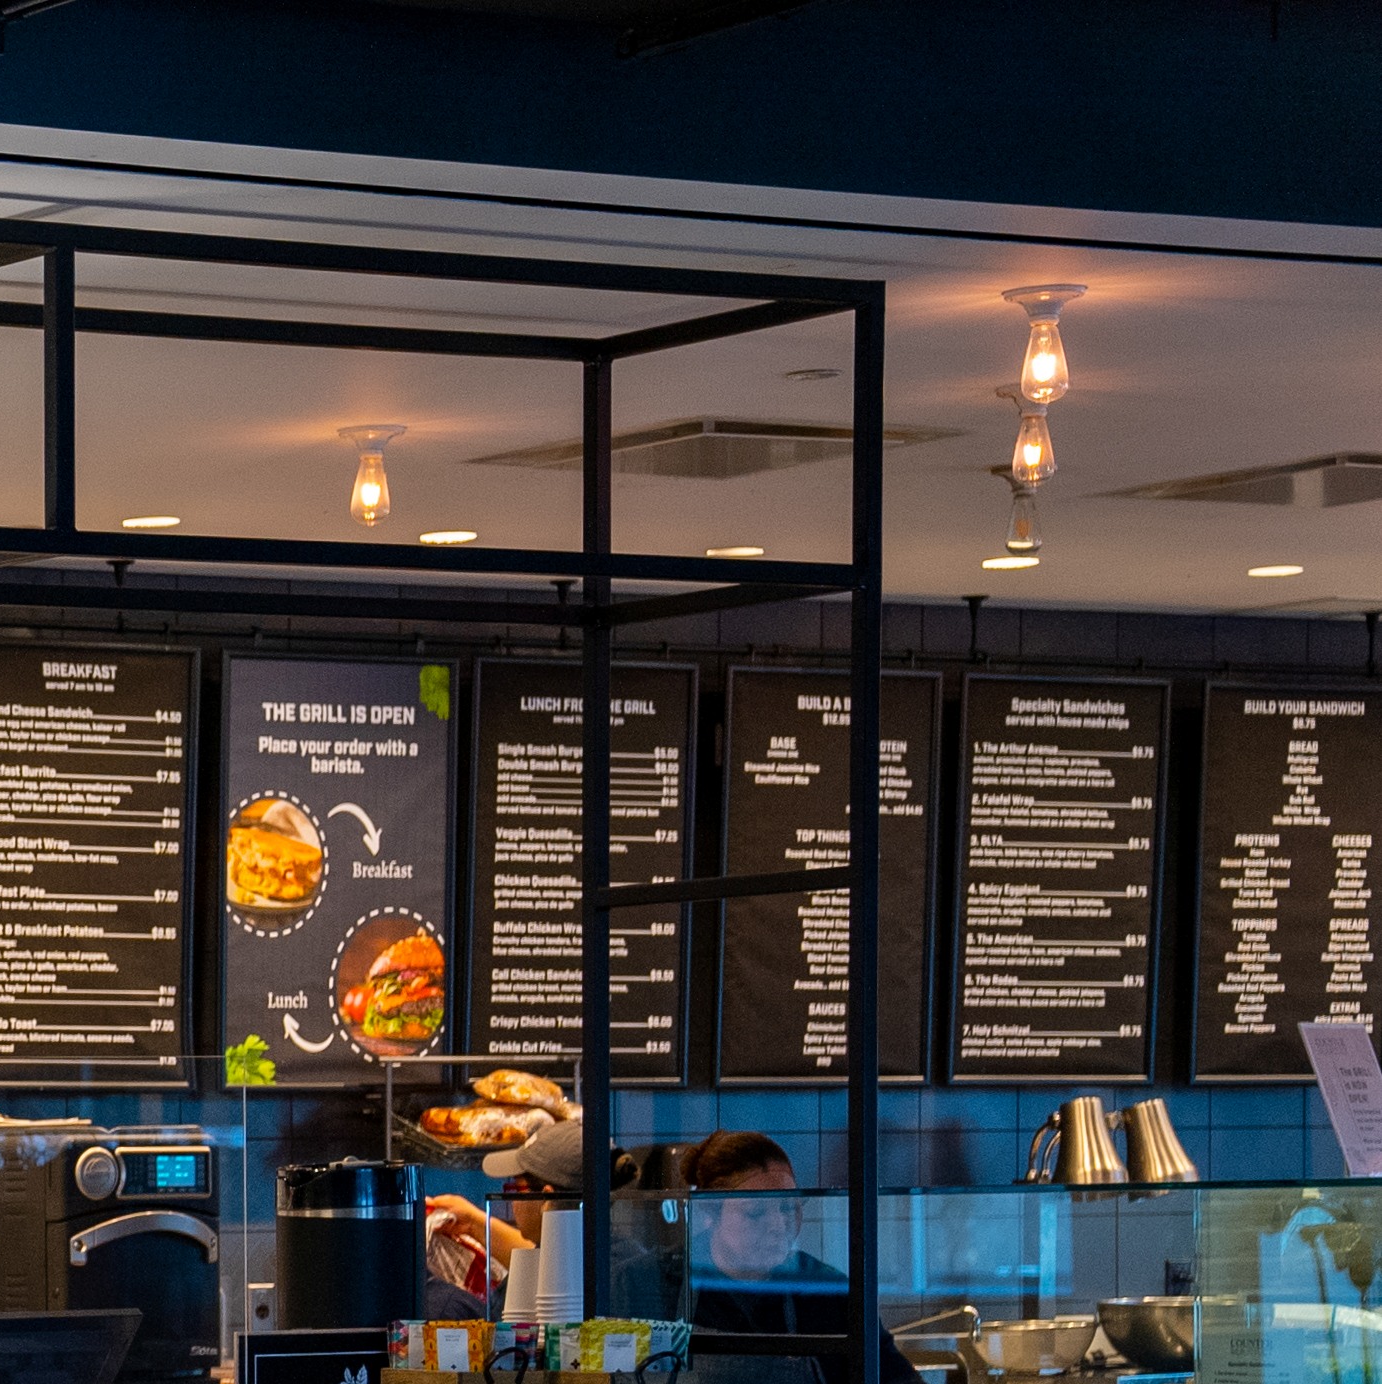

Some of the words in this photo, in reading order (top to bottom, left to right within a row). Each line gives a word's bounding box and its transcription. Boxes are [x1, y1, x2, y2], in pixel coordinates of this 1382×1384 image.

[42, 662, 117, 679] BREAKFAST
[12, 704, 46, 718] Cheese
[47, 705, 93, 719] Sandwich
[262, 702, 296, 722] THE
[300, 703, 346, 724] GRILL
[350, 705, 367, 724] IS
[371, 706, 415, 725] OPEN
[521, 696, 561, 712] LUNCH
[624, 700, 656, 715] GRILL
[1011, 697, 1061, 715] Specialty
[1063, 699, 1125, 715] Sandwiches
[1244, 700, 1277, 715] BUILD
[1278, 700, 1307, 715] YOUR
[1309, 701, 1366, 716] SANDWICH
[259, 736, 297, 753] Place
[300, 739, 331, 757] your
[334, 738, 373, 756] order
[376, 738, 406, 756] with
[409, 743, 418, 757] a
[770, 736, 797, 750] BASE
[1289, 741, 1319, 754] BREAD
[311, 756, 365, 774] barista.
[796, 829, 816, 843] TOP
[1235, 834, 1280, 848] PROTEINS
[352, 861, 413, 879] Breakfast
[1231, 918, 1278, 932] TOPPINGS
[268, 990, 308, 1009] Lunch
[808, 1003, 846, 1016] SAUCES
